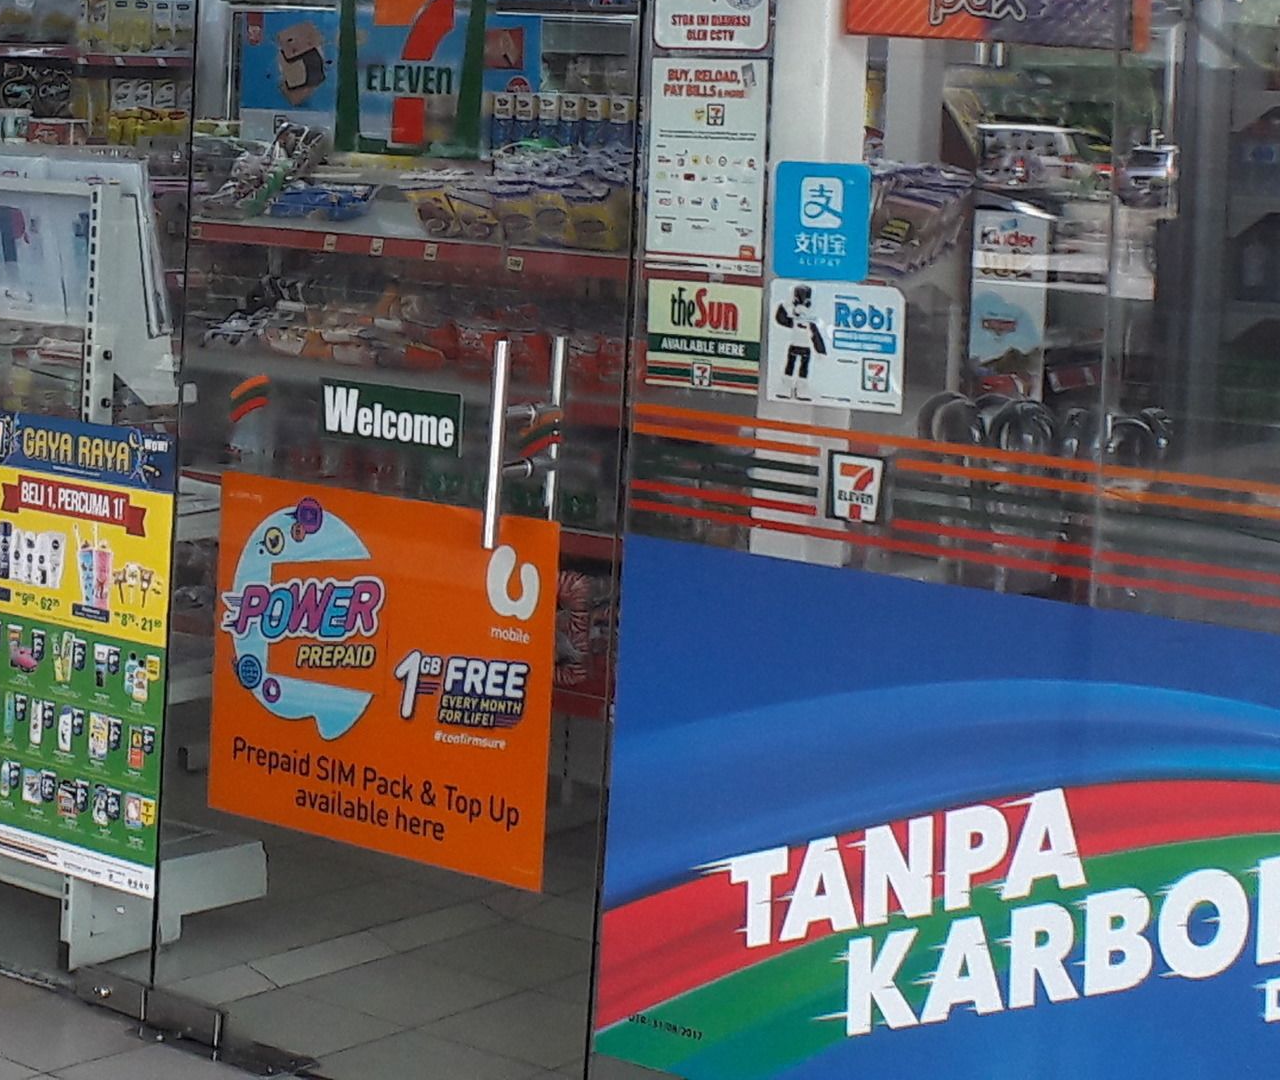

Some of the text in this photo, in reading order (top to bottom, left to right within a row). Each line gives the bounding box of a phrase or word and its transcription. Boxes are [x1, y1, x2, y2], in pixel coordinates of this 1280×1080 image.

[663, 83, 684, 97] PAY
[793, 232, 847, 257] 支付宝
[834, 302, 893, 331] Robi
[661, 337, 746, 357] AVAILABLE HERE
[323, 384, 455, 448] Welcome
[23, 427, 130, 473] GAYA RAYA
[21, 481, 44, 506] BELI
[58, 487, 110, 517] PERCUMA
[235, 579, 382, 639] POWER
[491, 626, 531, 644] mobile
[297, 645, 375, 668] PREPAID
[445, 657, 530, 698] FREE
[439, 709, 495, 726] FOR LIFE!
[441, 694, 522, 714] EVERY MONTH
[434, 730, 506, 750] #confirmsure
[233, 736, 520, 832] Prepaid SIM Pack & Top Up
[295, 788, 445, 841] available here
[710, 787, 1087, 948] TANPA
